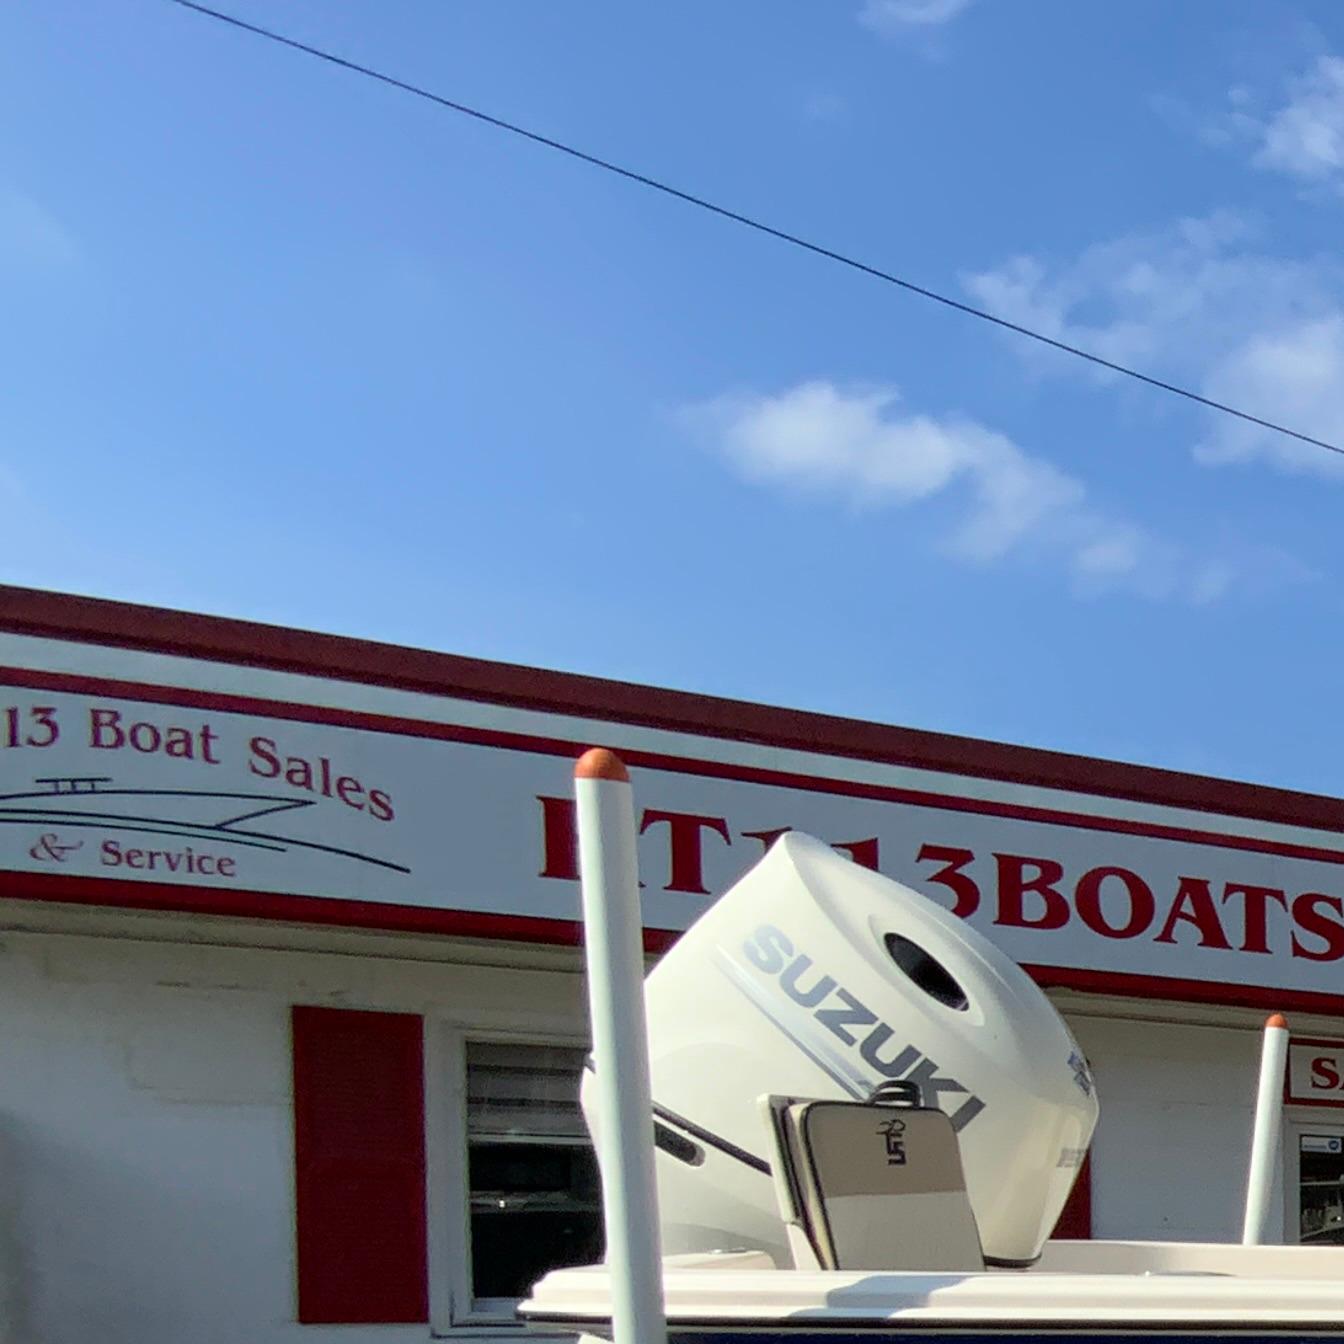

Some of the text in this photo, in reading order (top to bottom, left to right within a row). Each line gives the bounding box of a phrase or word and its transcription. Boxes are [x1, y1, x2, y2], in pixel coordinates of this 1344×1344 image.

[88, 707, 221, 764] Boat
[248, 736, 396, 821] Sales
[28, 832, 237, 877] & Service
[742, 923, 988, 1132] SUZUKI
